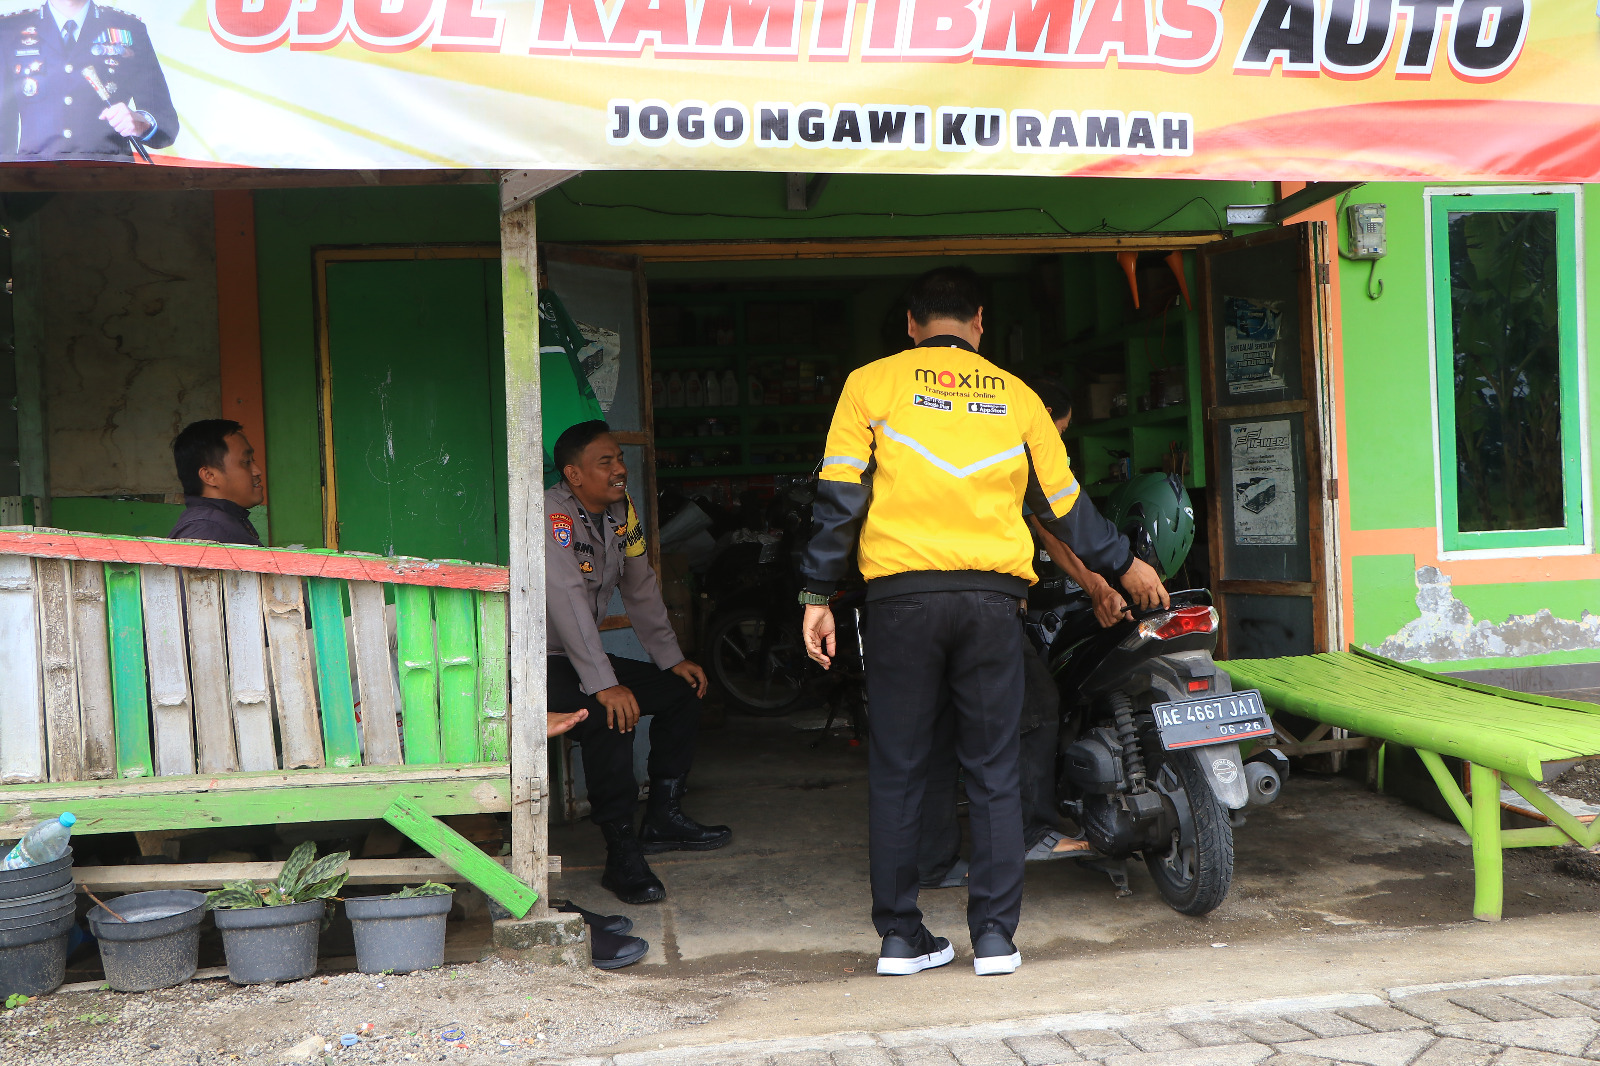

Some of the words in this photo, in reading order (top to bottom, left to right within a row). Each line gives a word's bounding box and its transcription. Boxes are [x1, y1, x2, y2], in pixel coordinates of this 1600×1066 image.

[1233, 0, 1531, 84] AUTO
[612, 105, 744, 141] JOGO
[760, 108, 926, 144] NGAWI
[942, 113, 1000, 146] KU
[1016, 115, 1188, 150] RAMAH
[915, 368, 1006, 391] maxim
[924, 386, 970, 397] Transportasi
[973, 391, 996, 399] Online
[1162, 708, 1183, 727] AE
[1187, 702, 1223, 722] 4667
[1230, 698, 1257, 717] JAI
